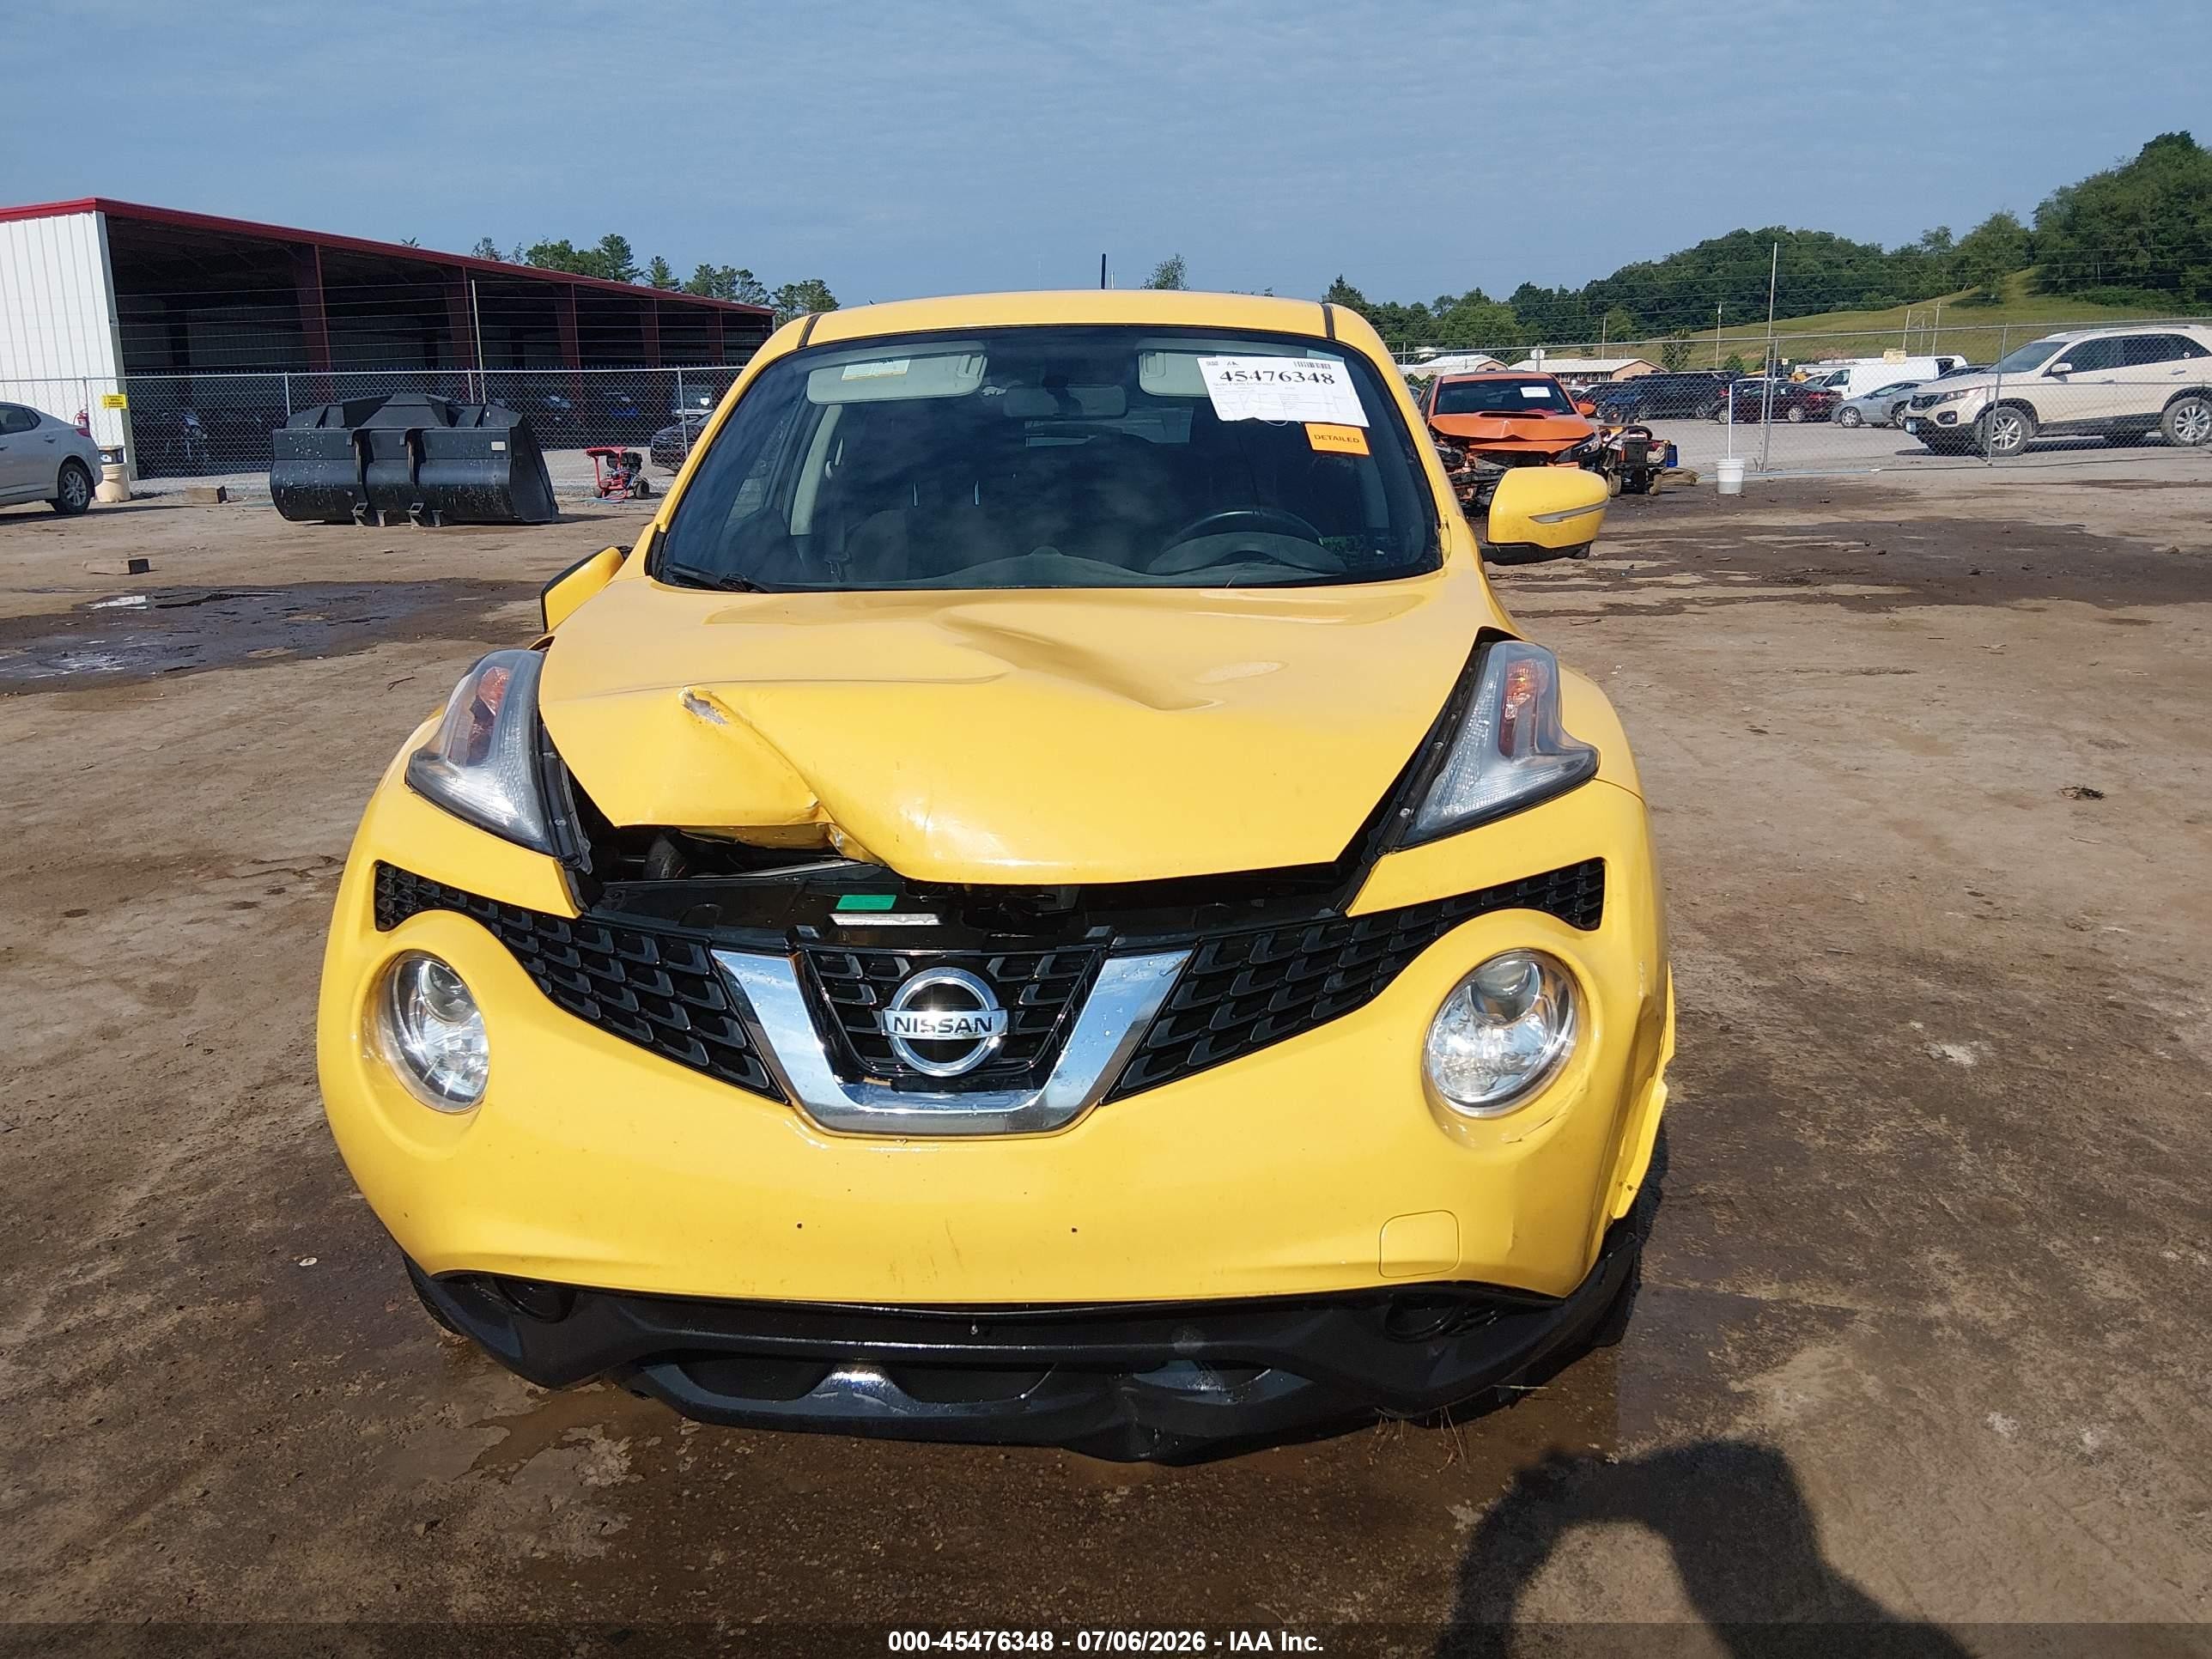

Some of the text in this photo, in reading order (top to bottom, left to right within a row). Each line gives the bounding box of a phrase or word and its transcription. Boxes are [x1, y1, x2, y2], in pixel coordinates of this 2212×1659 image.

[1219, 370, 1335, 385] 45476348
[1314, 434, 1360, 443] DETAILED
[894, 1016, 993, 1033] NISSAN
